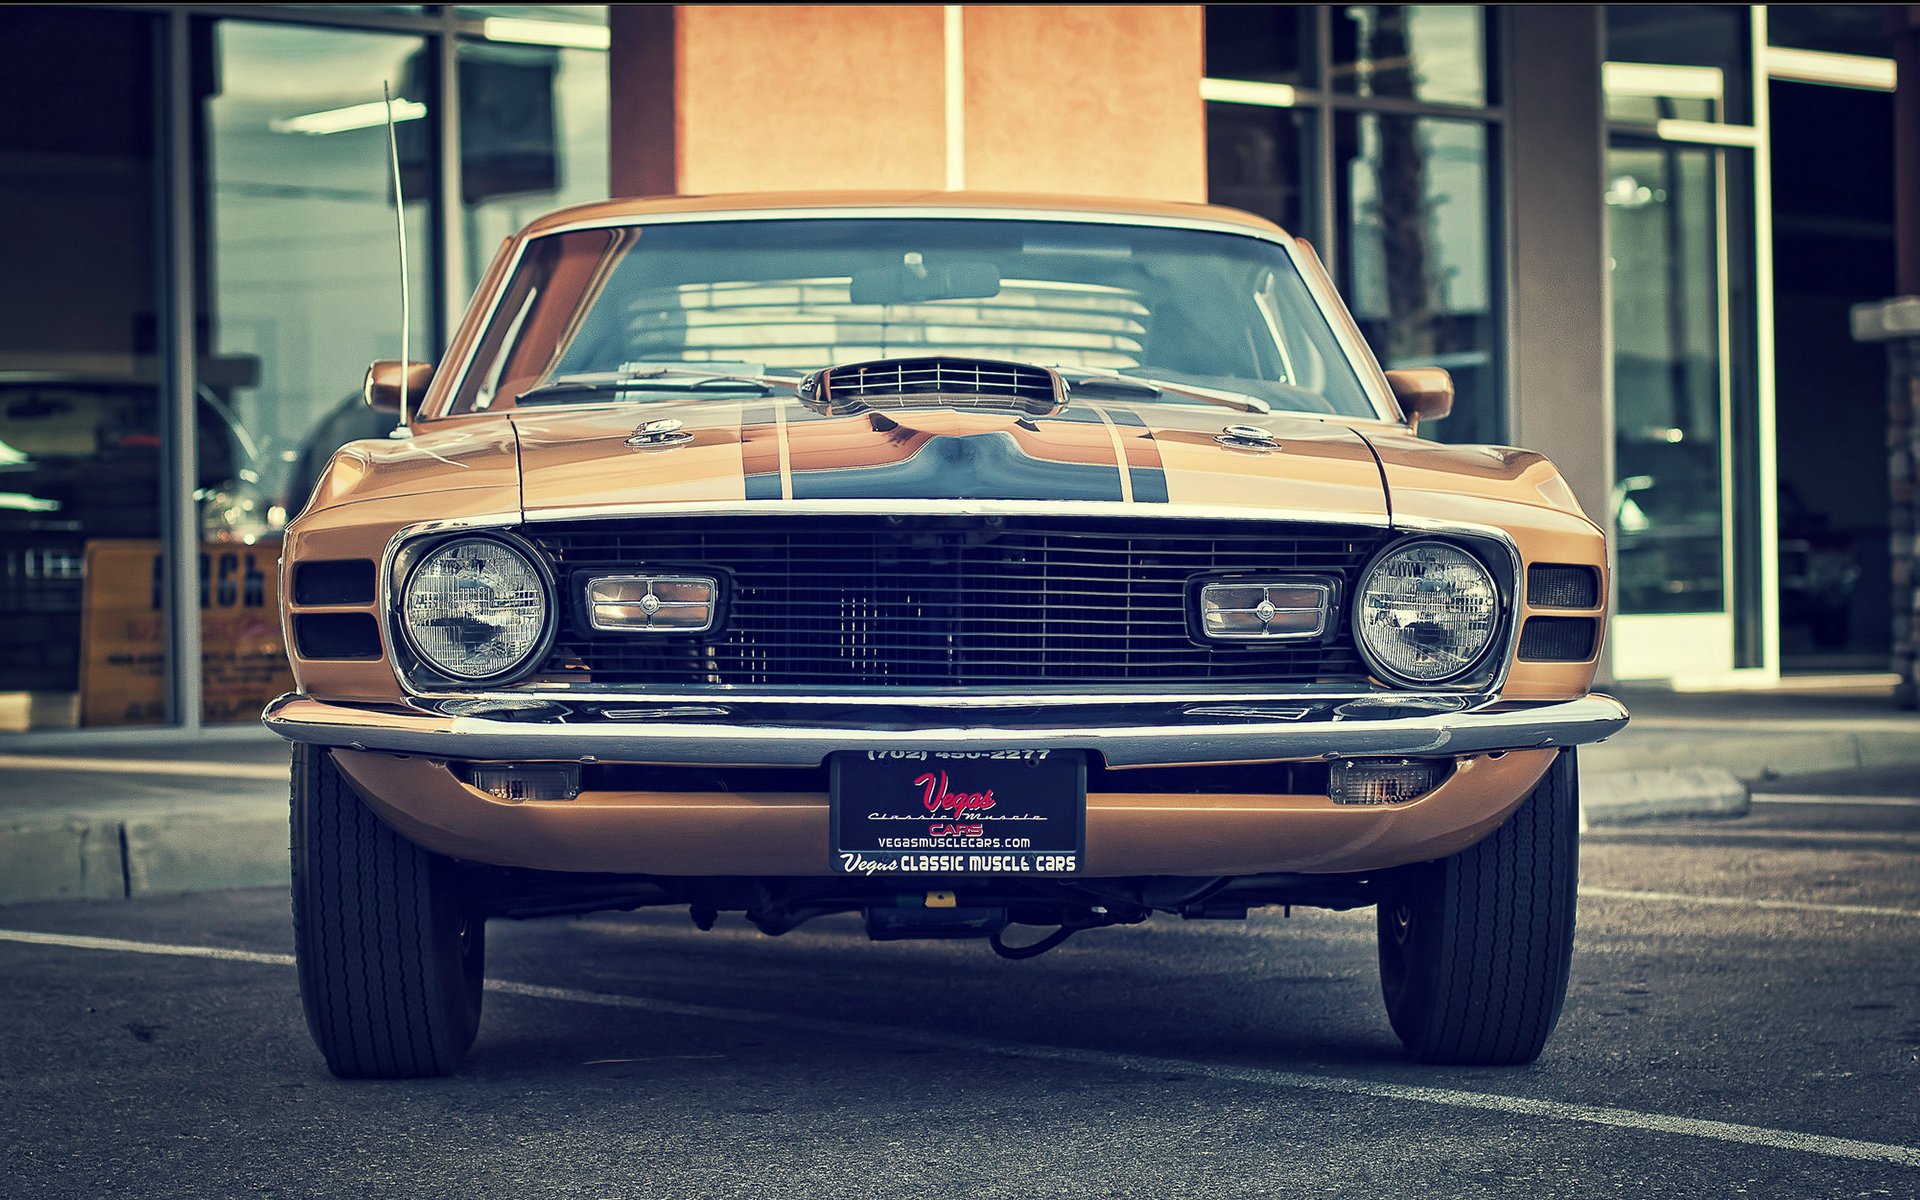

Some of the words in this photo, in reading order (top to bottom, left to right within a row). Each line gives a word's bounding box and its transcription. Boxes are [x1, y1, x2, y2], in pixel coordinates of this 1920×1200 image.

[913, 769, 996, 821] Vegas
[867, 812, 954, 821] Classic
[960, 812, 1048, 821] Muscle
[928, 823, 984, 837] CARS
[839, 853, 899, 876] Vegas
